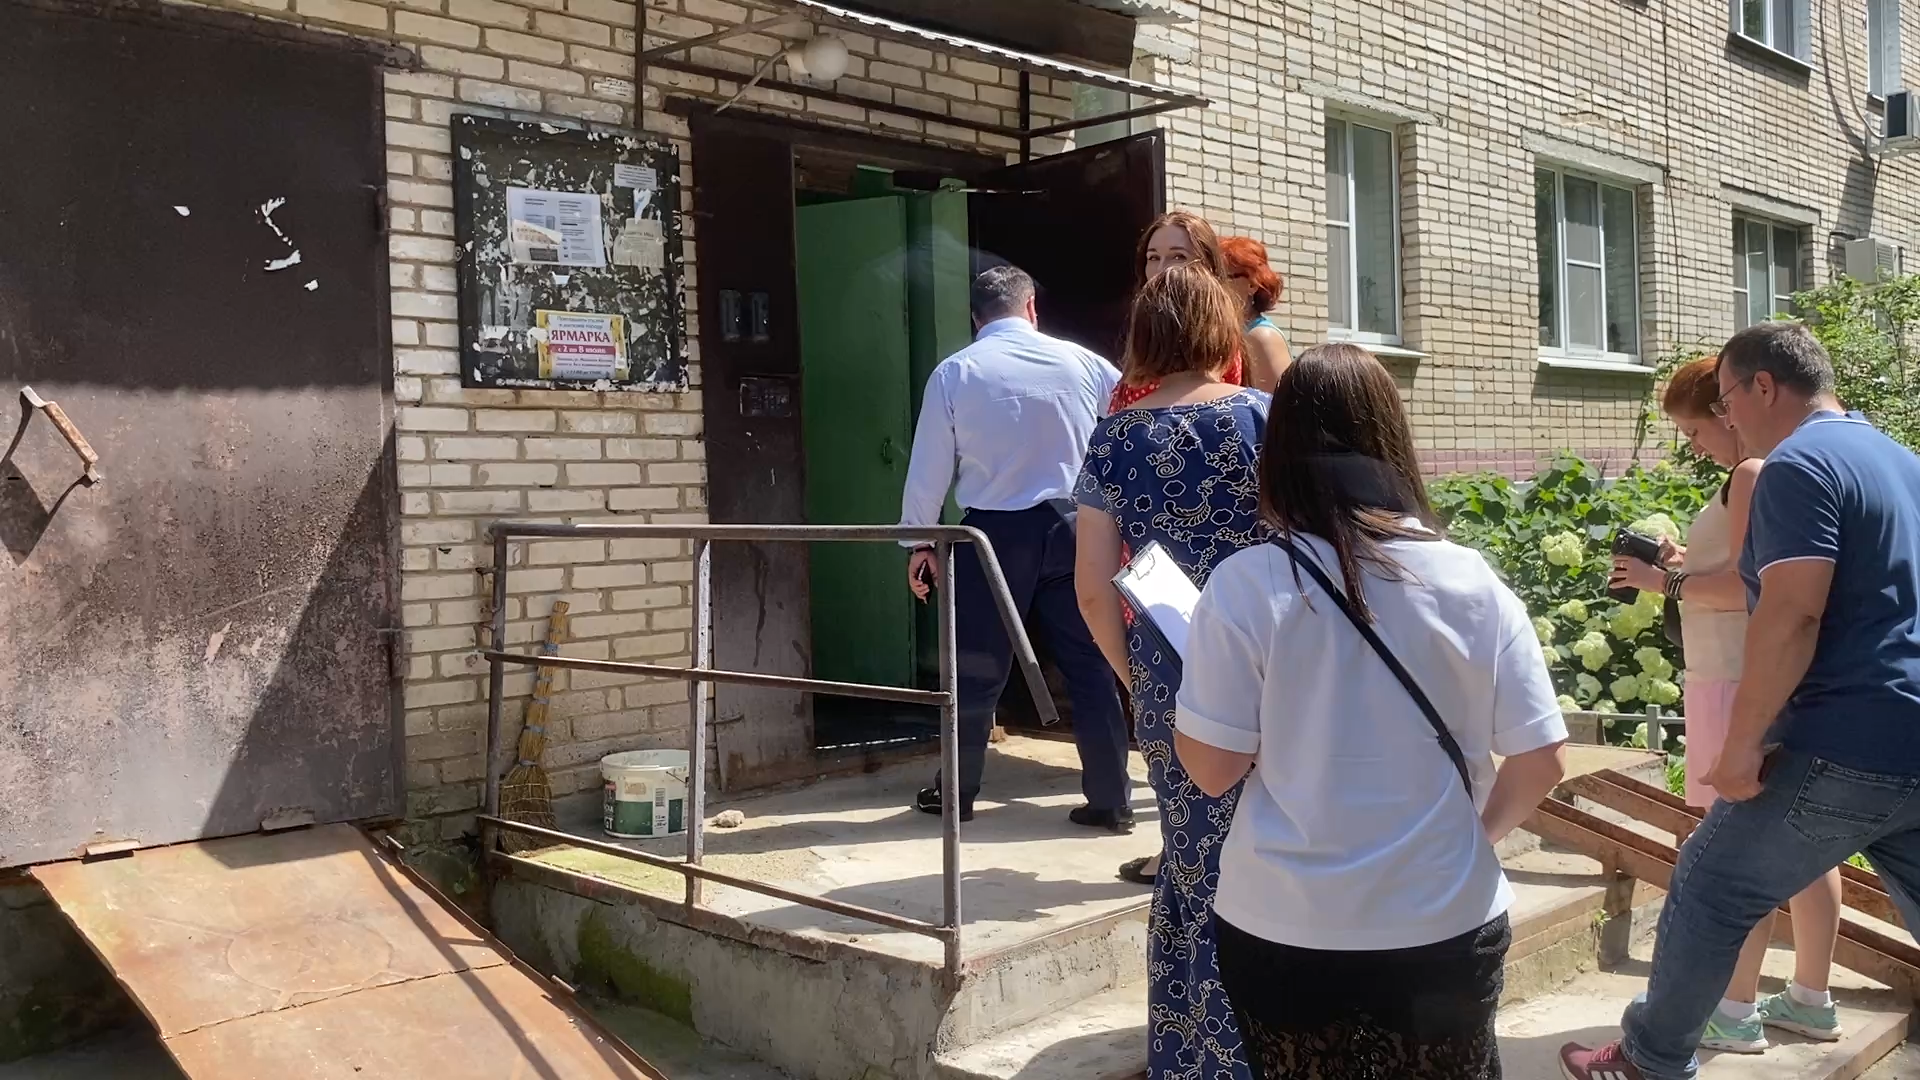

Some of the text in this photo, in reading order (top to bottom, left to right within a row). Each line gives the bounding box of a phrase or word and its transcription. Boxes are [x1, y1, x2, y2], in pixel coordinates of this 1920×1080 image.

[551, 329, 611, 343] ЯРМАРКА
[563, 345, 568, 353] 2
[579, 345, 584, 353] 8
